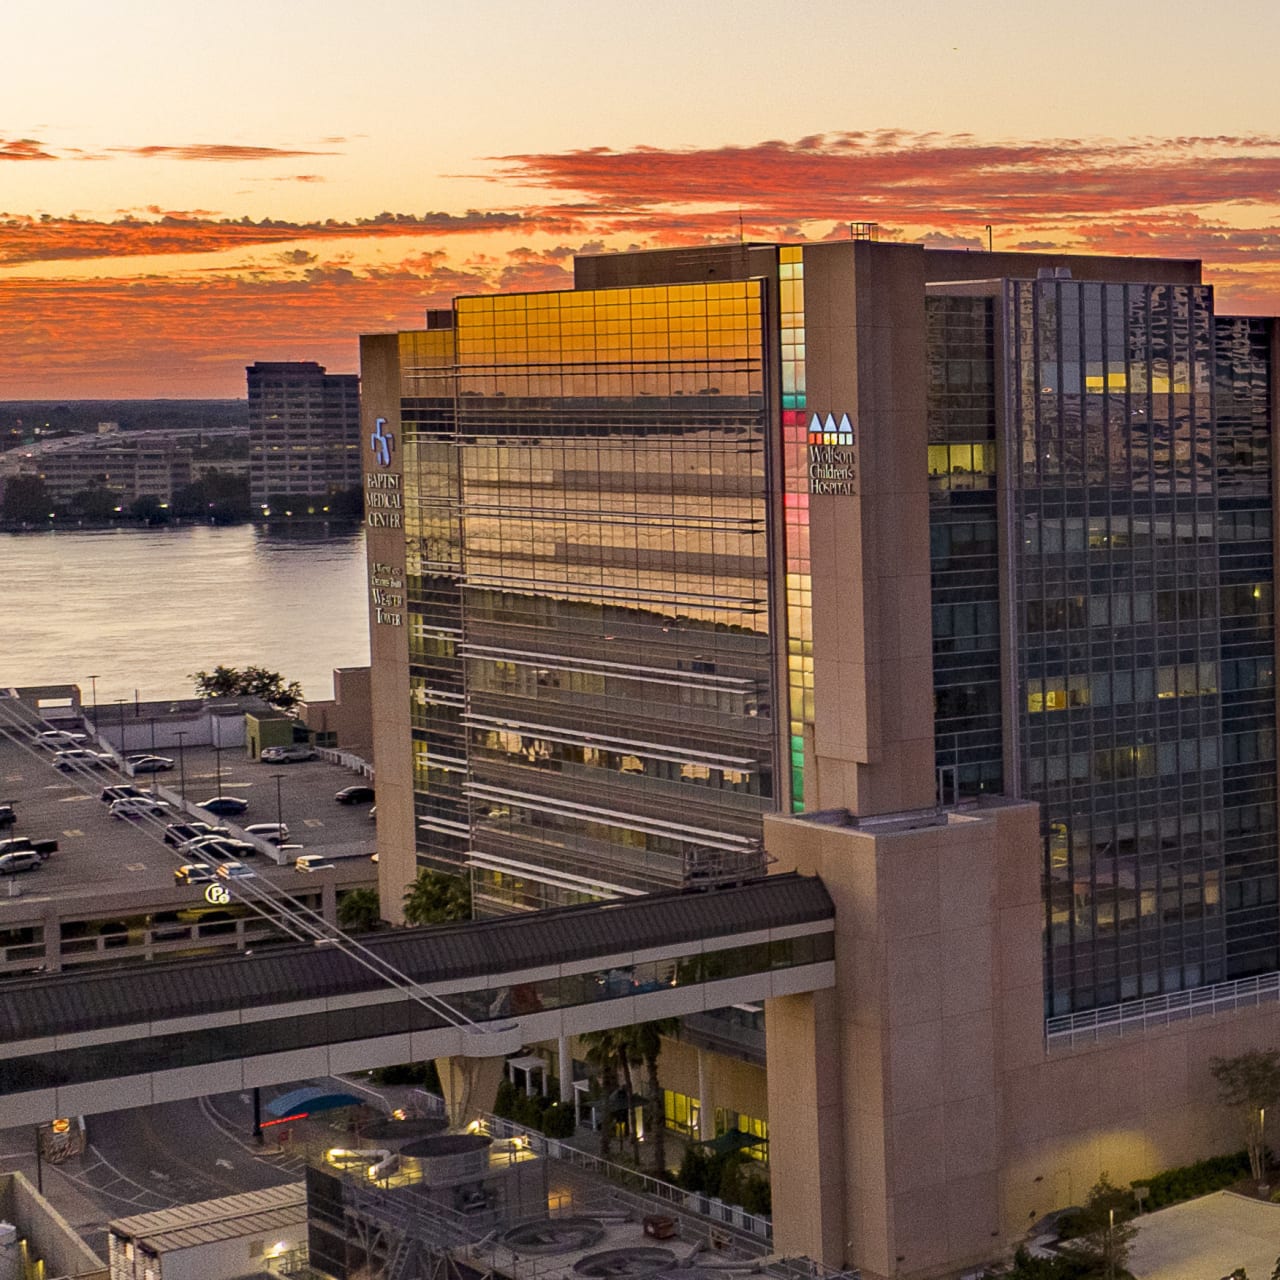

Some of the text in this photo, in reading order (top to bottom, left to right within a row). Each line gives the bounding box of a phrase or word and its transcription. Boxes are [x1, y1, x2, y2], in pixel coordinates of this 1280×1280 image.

[809, 446, 854, 464] Wolfson
[809, 463, 854, 480] Children's
[366, 473, 401, 489] BAPTIST
[366, 491, 402, 509] MEDICAL
[368, 512, 401, 528] CENTER
